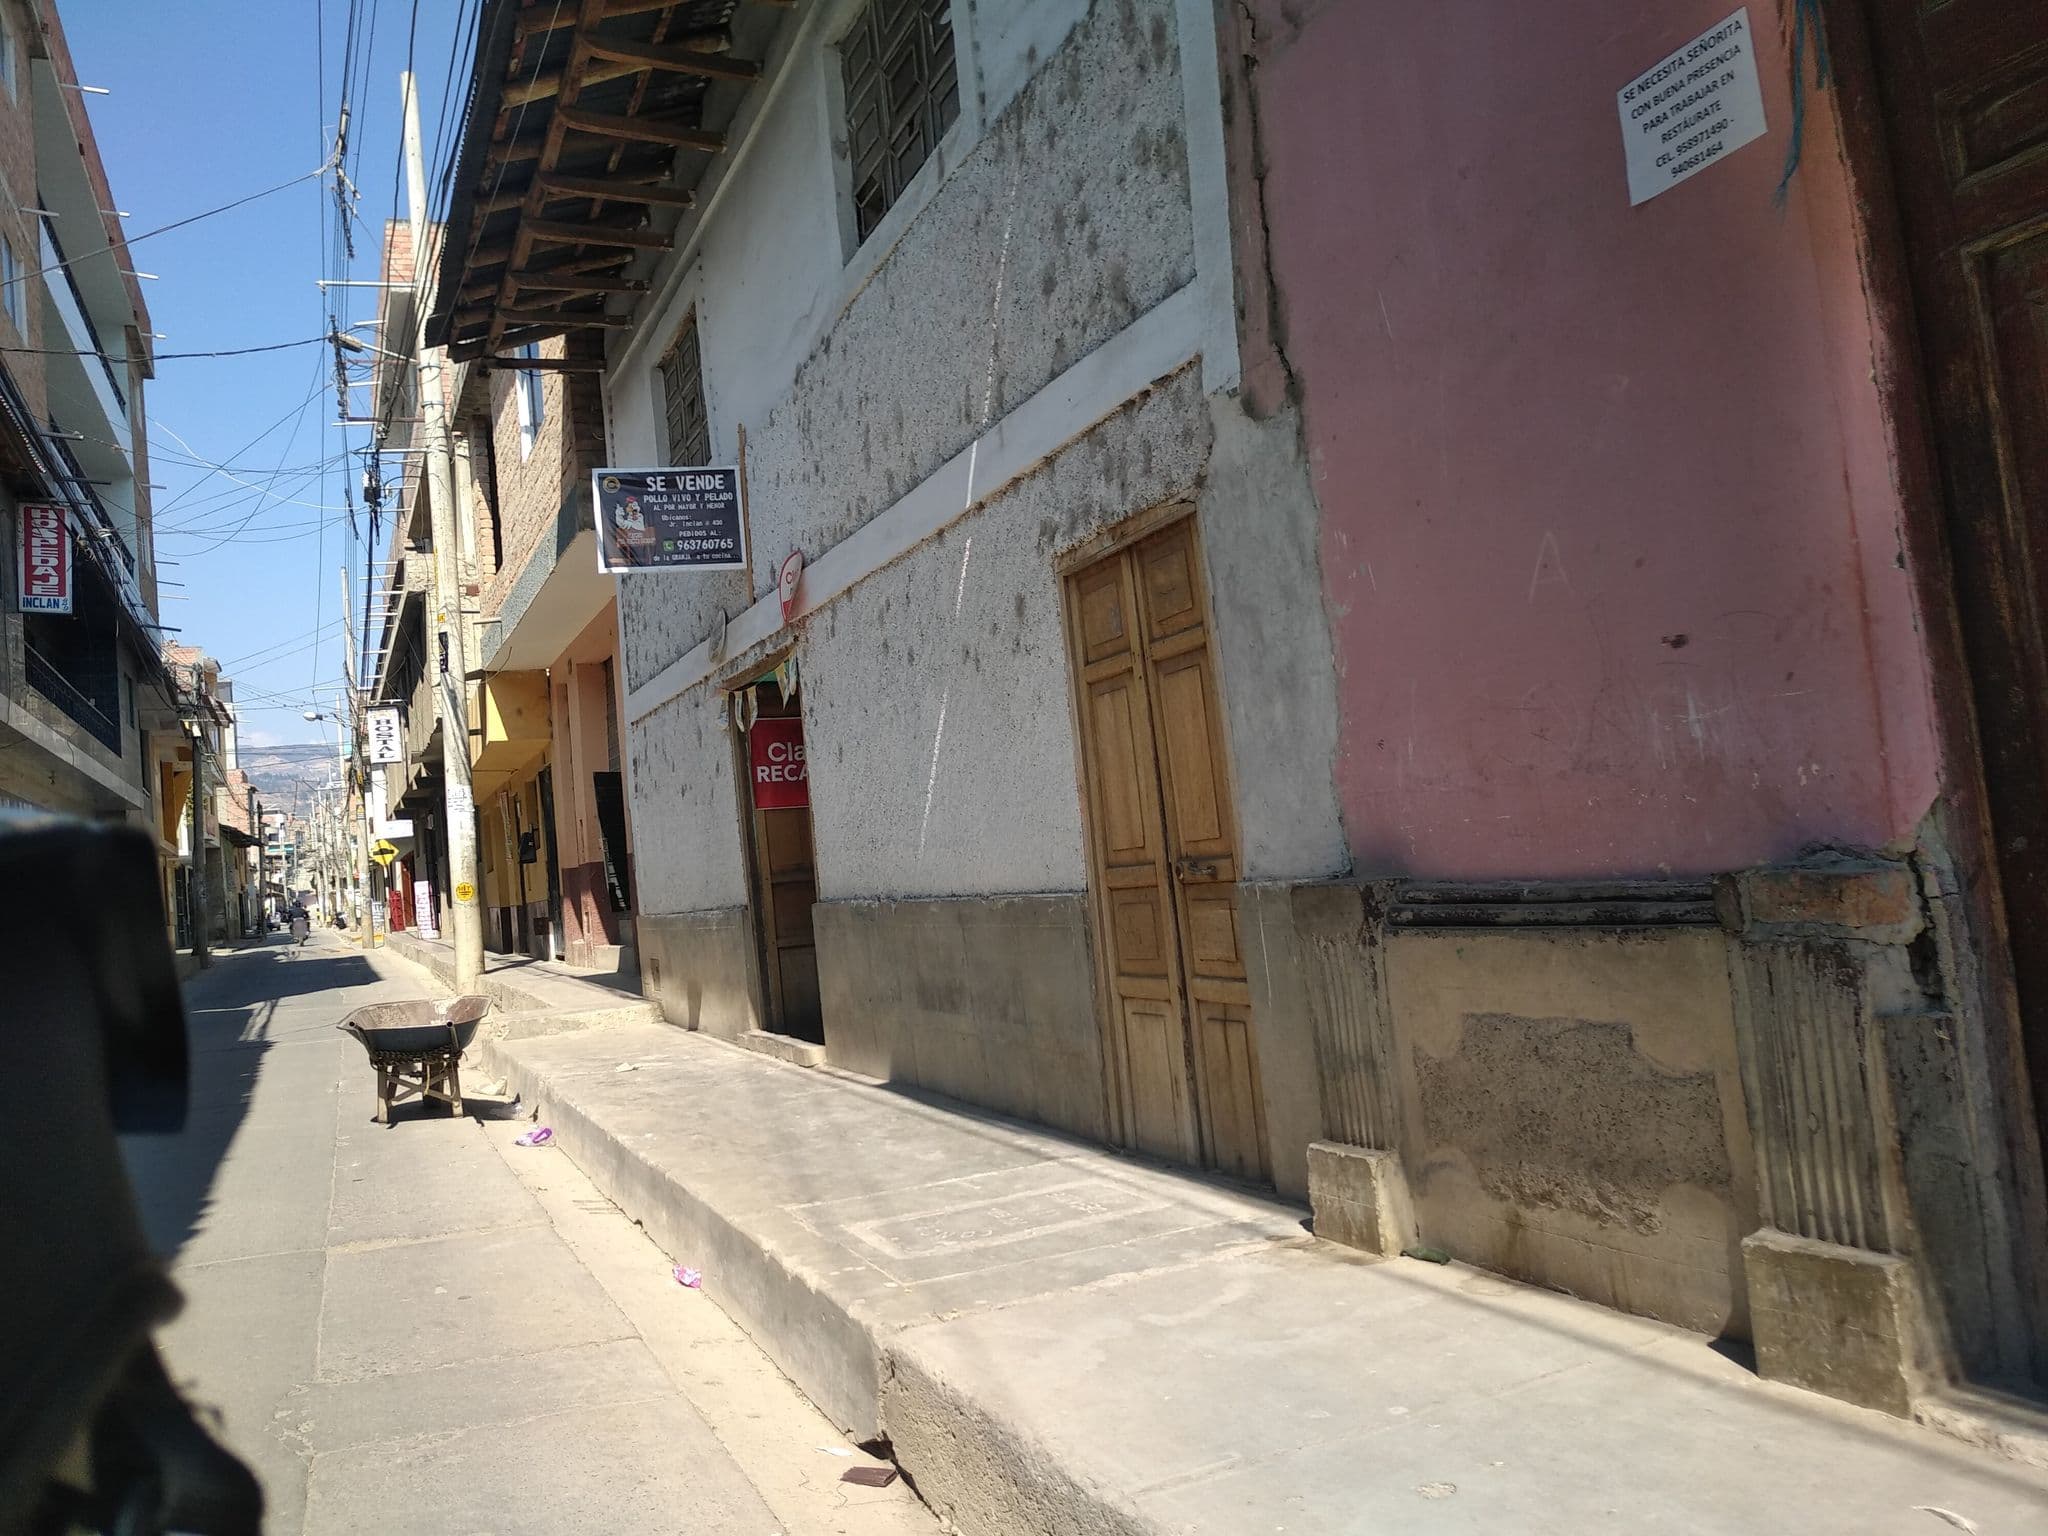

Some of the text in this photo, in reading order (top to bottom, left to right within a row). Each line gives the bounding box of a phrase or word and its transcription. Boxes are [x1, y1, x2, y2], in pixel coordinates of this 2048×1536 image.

[1623, 20, 1742, 104] SE NECESITA SEÑORITA
[1631, 44, 1741, 119] CON BUENA PRESENCIA
[1642, 70, 1735, 134] PARA TRABAJAR EN
[643, 492, 733, 503] POLLO VIVO Y PELADO
[646, 474, 725, 492] SE VENDE
[706, 502, 726, 510] MENOR
[31, 507, 60, 596] HOSPEDAJE
[677, 538, 734, 551] 963760765
[22, 597, 60, 609] INCLAN
[374, 718, 396, 760] HOSTAL
